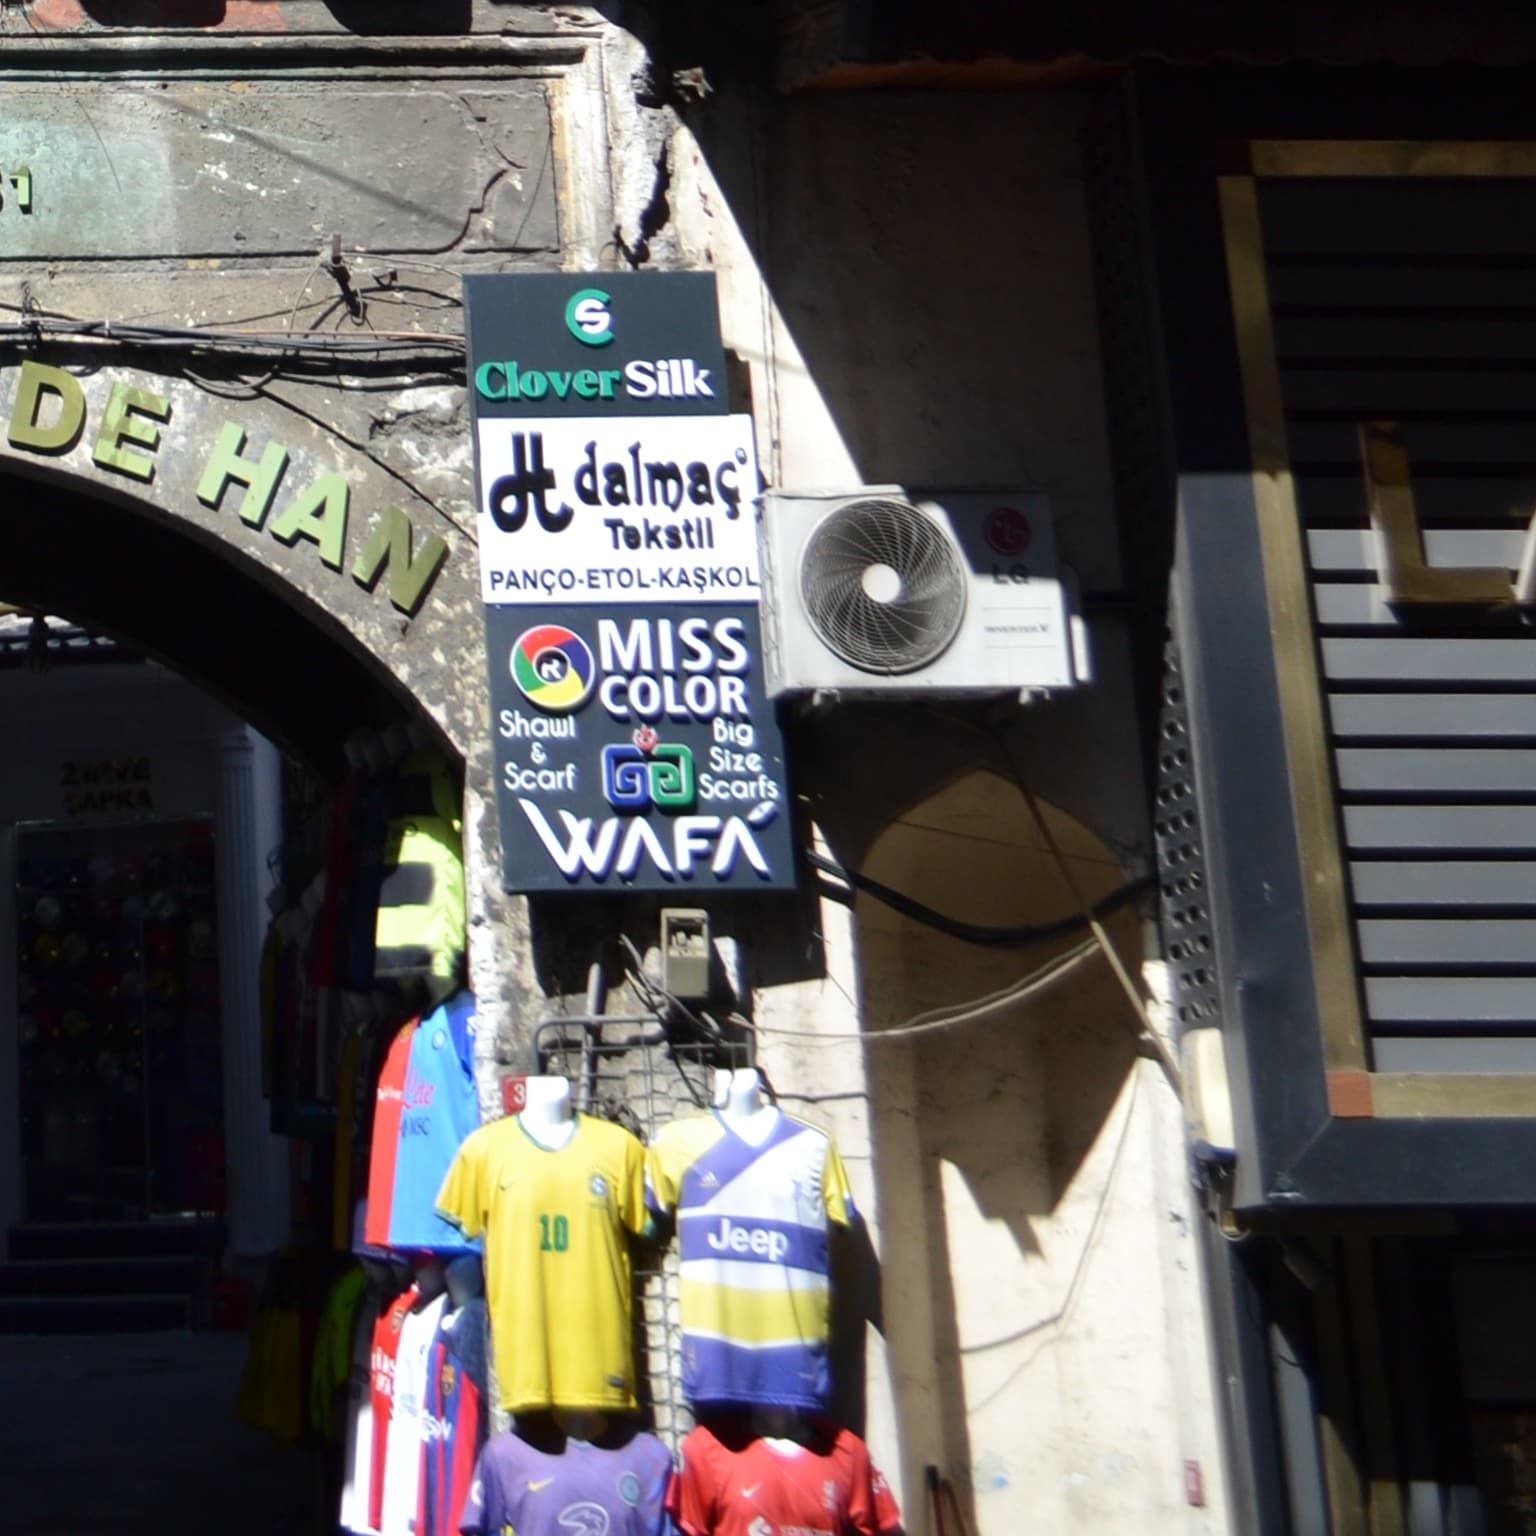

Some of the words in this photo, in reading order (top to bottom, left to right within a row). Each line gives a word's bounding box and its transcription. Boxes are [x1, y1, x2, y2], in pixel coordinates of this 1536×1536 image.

[574, 440, 741, 520] dalmaç
[196, 421, 449, 614] HAN
[604, 517, 715, 550] Tekstil
[597, 617, 749, 672] MISS
[599, 675, 749, 715] COLOR
[499, 709, 576, 739] Shawl
[713, 716, 755, 746] Big
[709, 745, 763, 773] Size
[504, 762, 577, 791] Scarf
[699, 773, 779, 800] Scarfs
[707, 1217, 789, 1262] Jeep
